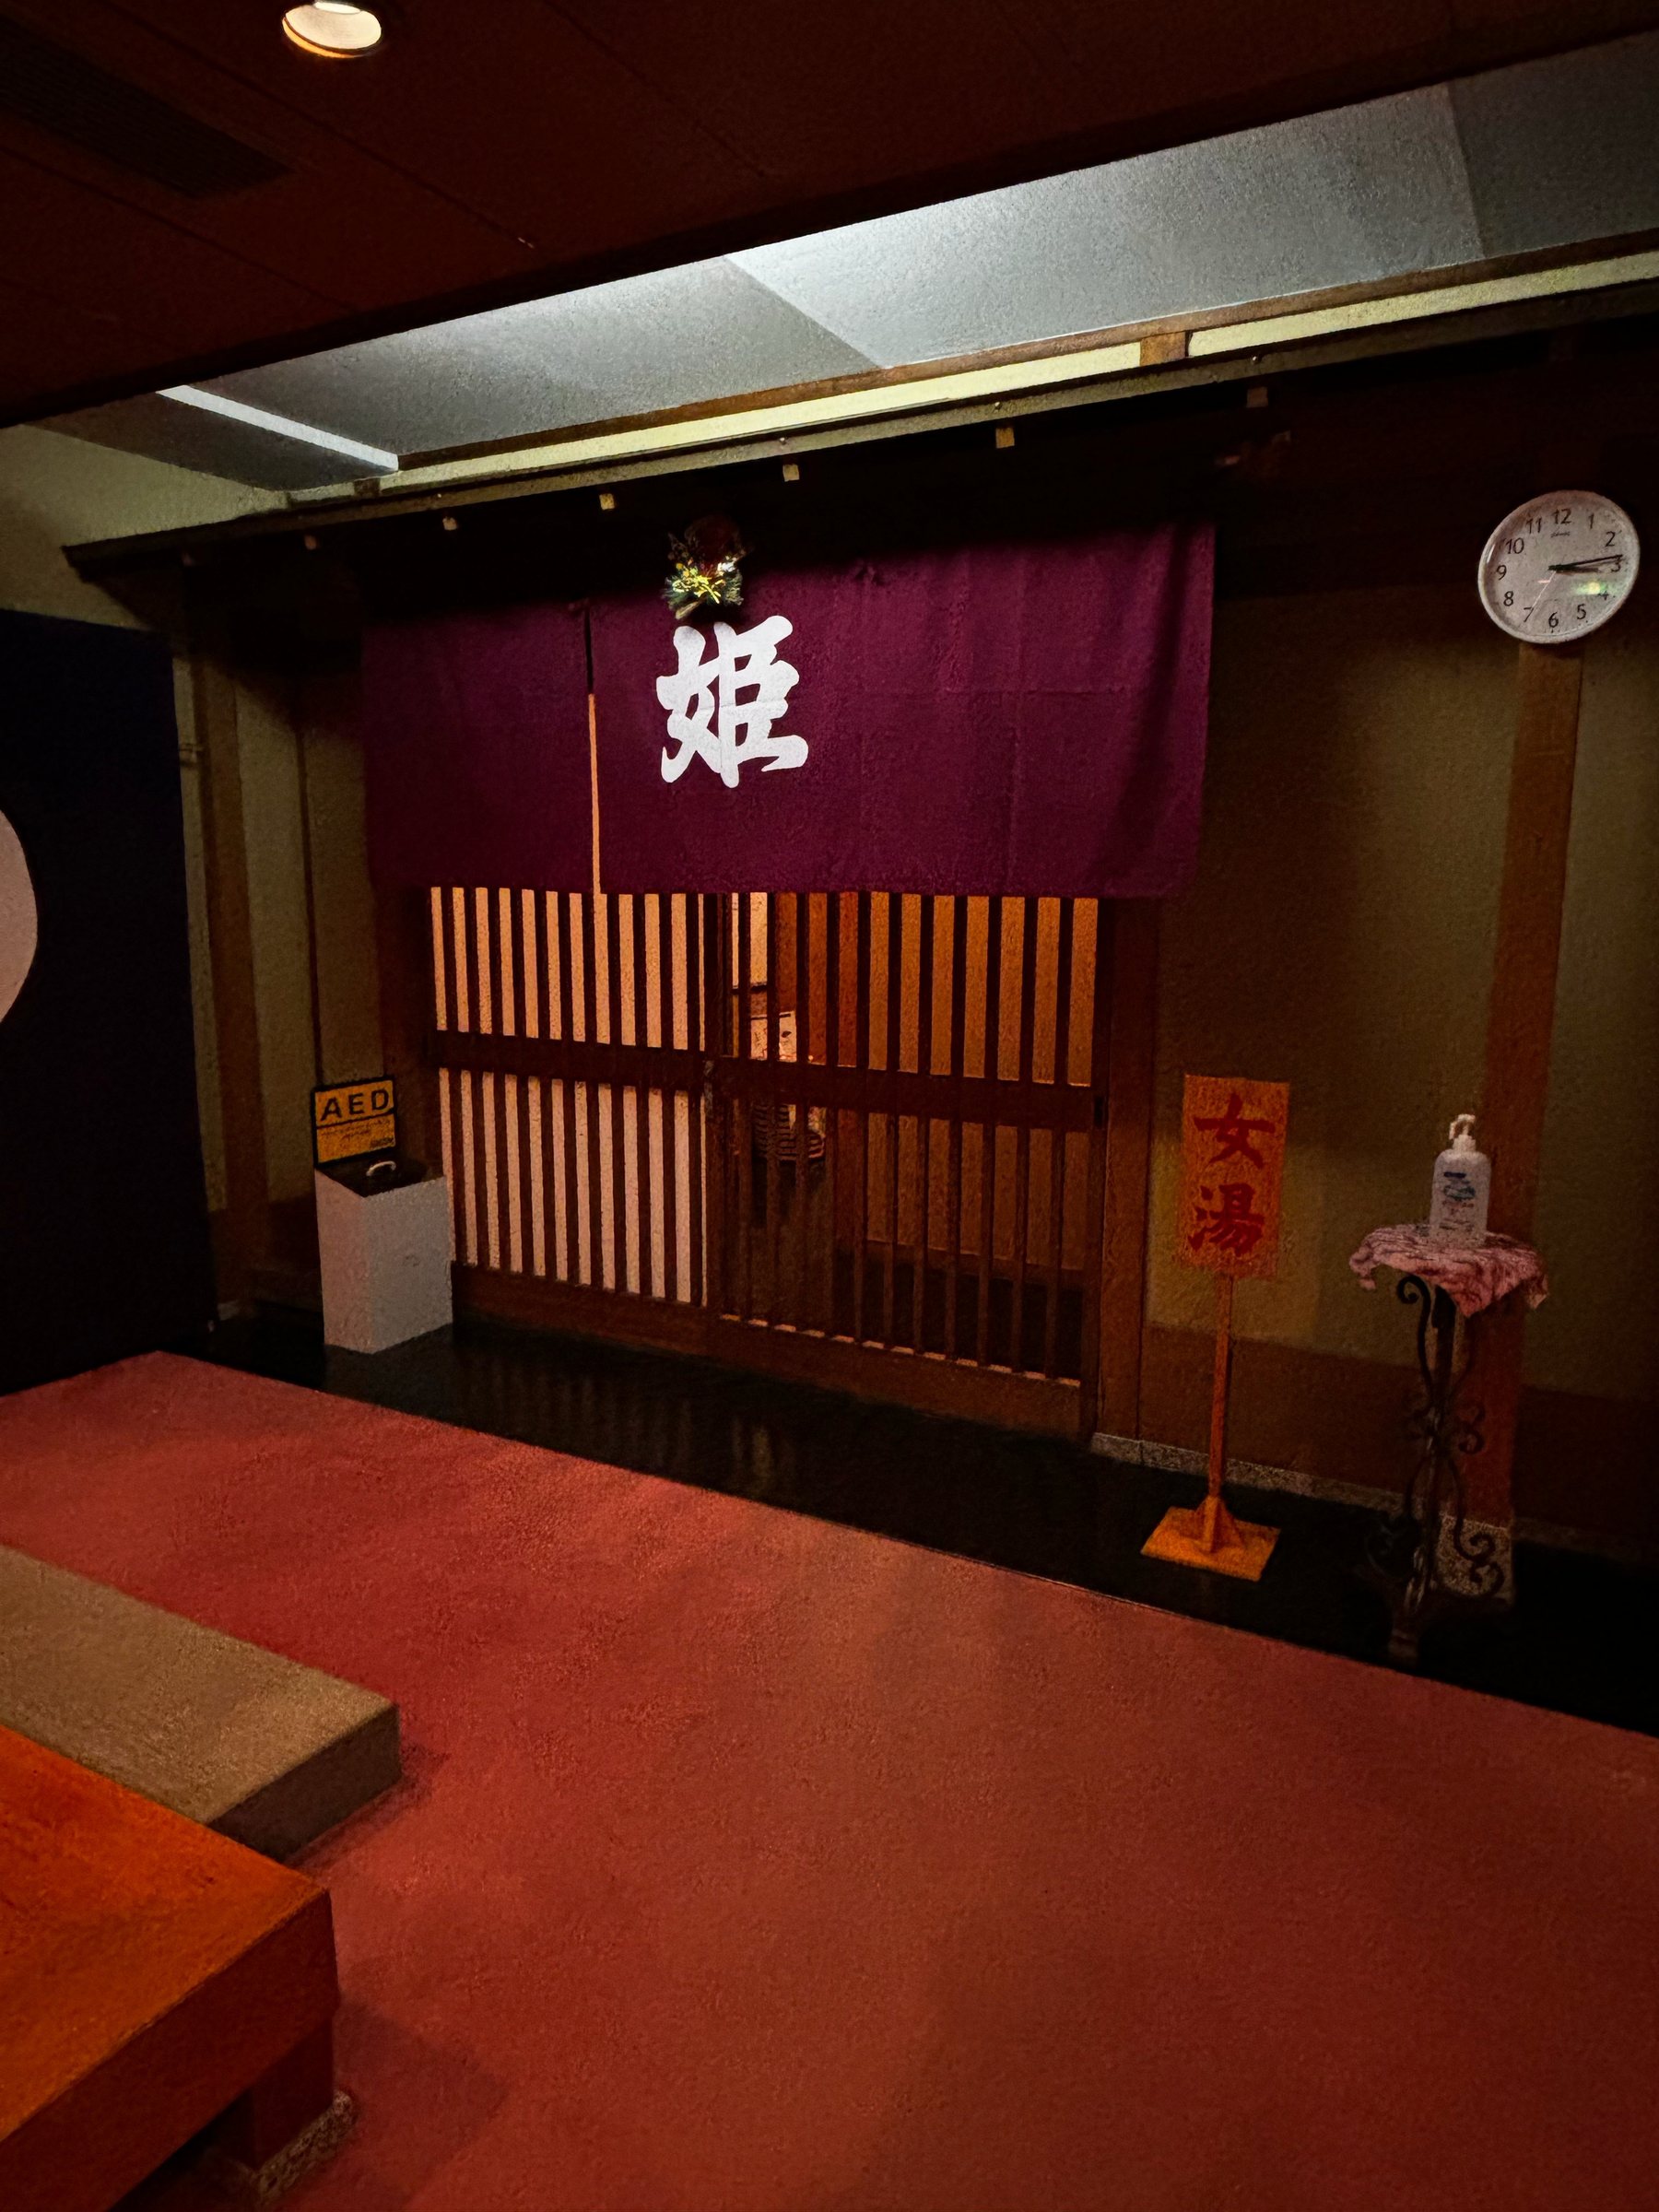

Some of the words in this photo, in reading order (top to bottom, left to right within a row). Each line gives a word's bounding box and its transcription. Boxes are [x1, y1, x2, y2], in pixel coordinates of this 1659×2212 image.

[1552, 508, 1572, 524] 12
[1588, 513, 1594, 529] 1
[1525, 517, 1542, 534] 11
[1505, 537, 1525, 555] 10
[1605, 531, 1616, 547] 2
[1610, 555, 1622, 572] 3
[1496, 564, 1508, 581] 9
[1503, 591, 1514, 607] 8
[1597, 587, 1610, 601] 4
[1524, 606, 1535, 623] 7
[1548, 612, 1559, 629] 6
[1577, 604, 1587, 620] 5
[656, 615, 809, 789] 姫
[320, 1088, 389, 1121] AED
[1187, 1092, 1276, 1257] 女湯
